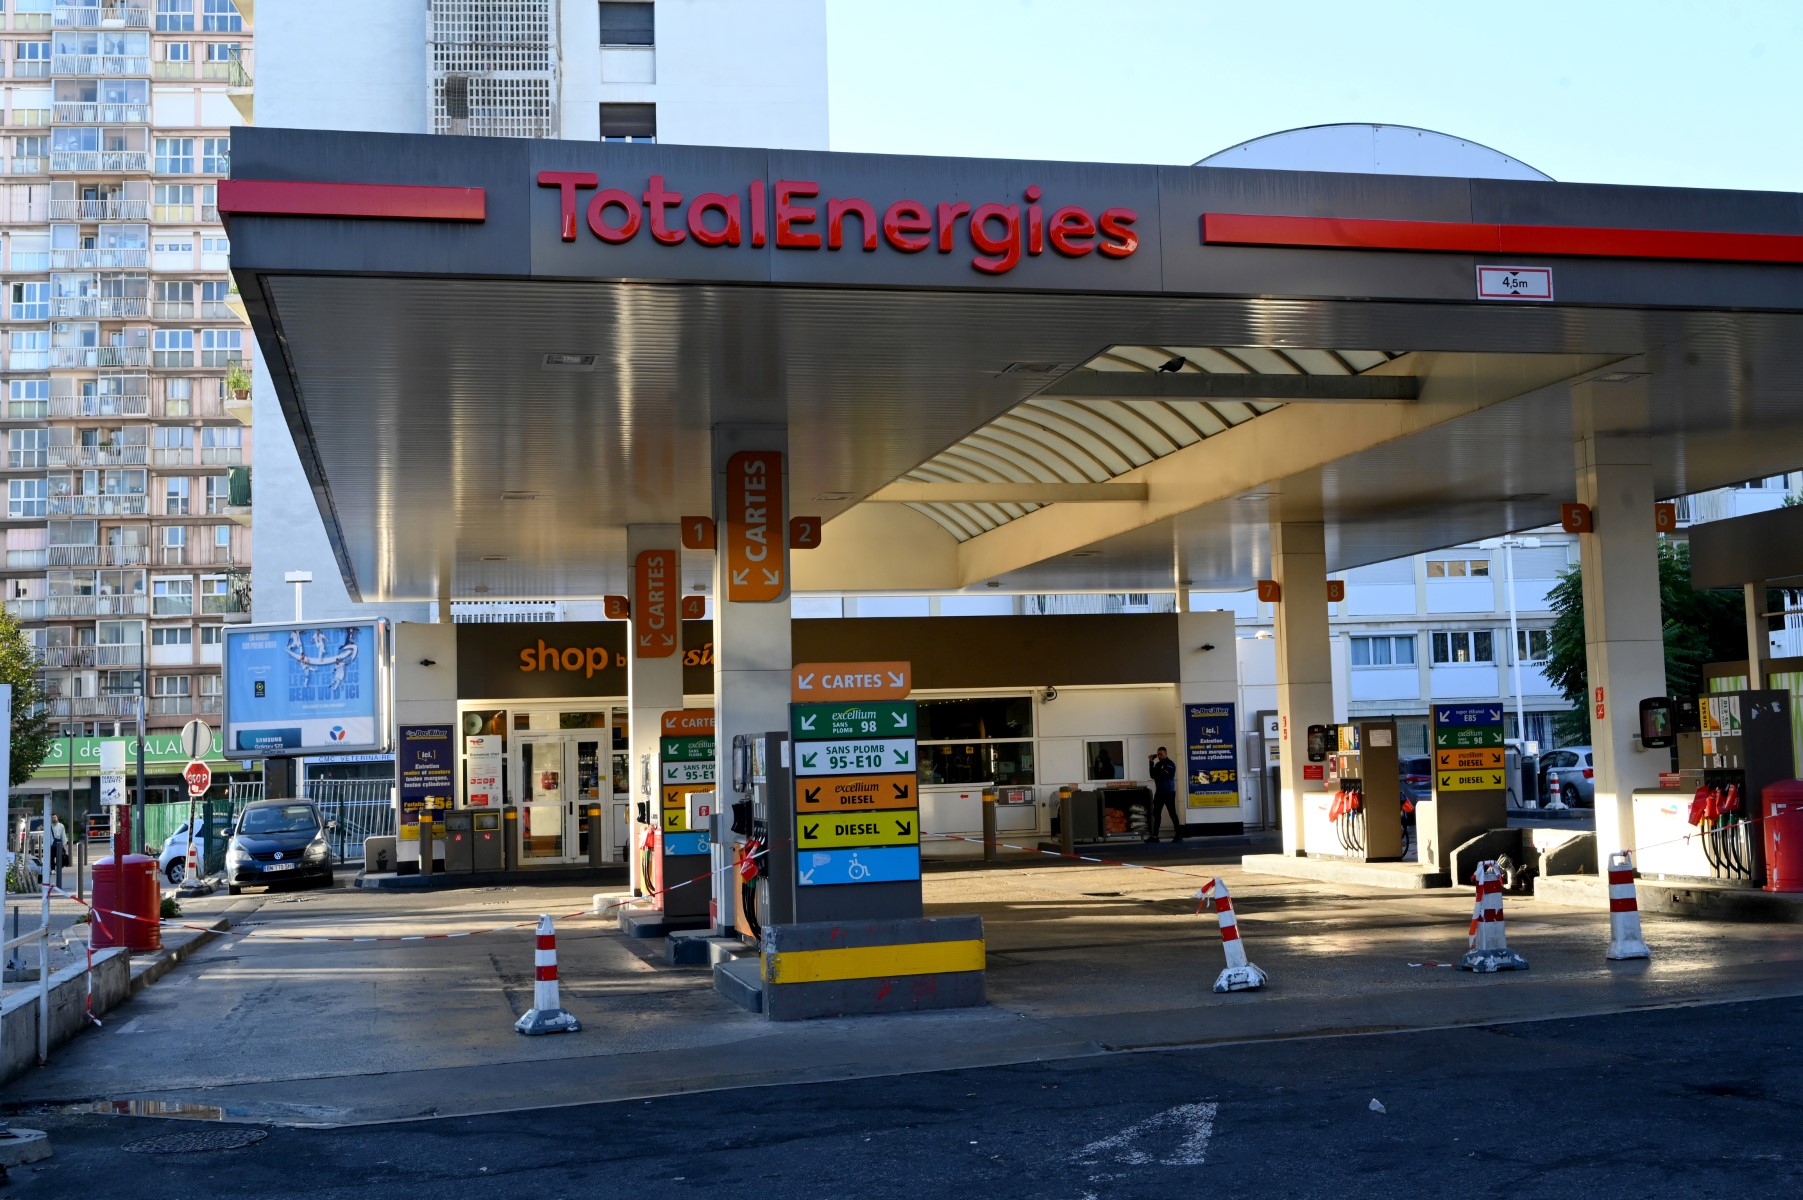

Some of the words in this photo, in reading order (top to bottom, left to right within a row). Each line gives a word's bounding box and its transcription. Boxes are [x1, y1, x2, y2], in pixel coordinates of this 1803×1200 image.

[537, 171, 1139, 274] TotalEnergies
[1502, 276, 1528, 289] 4,5m
[744, 459, 767, 562] CARTES
[1657, 508, 1668, 526] 6
[1571, 509, 1582, 527] 5
[694, 523, 703, 542] 1
[800, 523, 811, 542] 2
[648, 555, 664, 630] CARTES
[1264, 584, 1273, 598] 7
[1330, 584, 1339, 598] 8
[611, 600, 621, 615] 3
[688, 600, 699, 614] 4
[520, 639, 609, 679] shop
[822, 673, 882, 689] CARTES
[832, 709, 877, 721] excellium
[1464, 714, 1477, 722] E85
[861, 720, 877, 733] 98
[1473, 737, 1483, 745] 98
[826, 746, 850, 755] SANS
[853, 745, 885, 754] PLOMB
[829, 755, 882, 770] 95-E10
[1458, 759, 1484, 767] DIESEL
[1459, 776, 1485, 784] DIESEL
[834, 782, 880, 793] excellium
[840, 795, 875, 805] DIESEL
[835, 823, 880, 836] DIESEL
